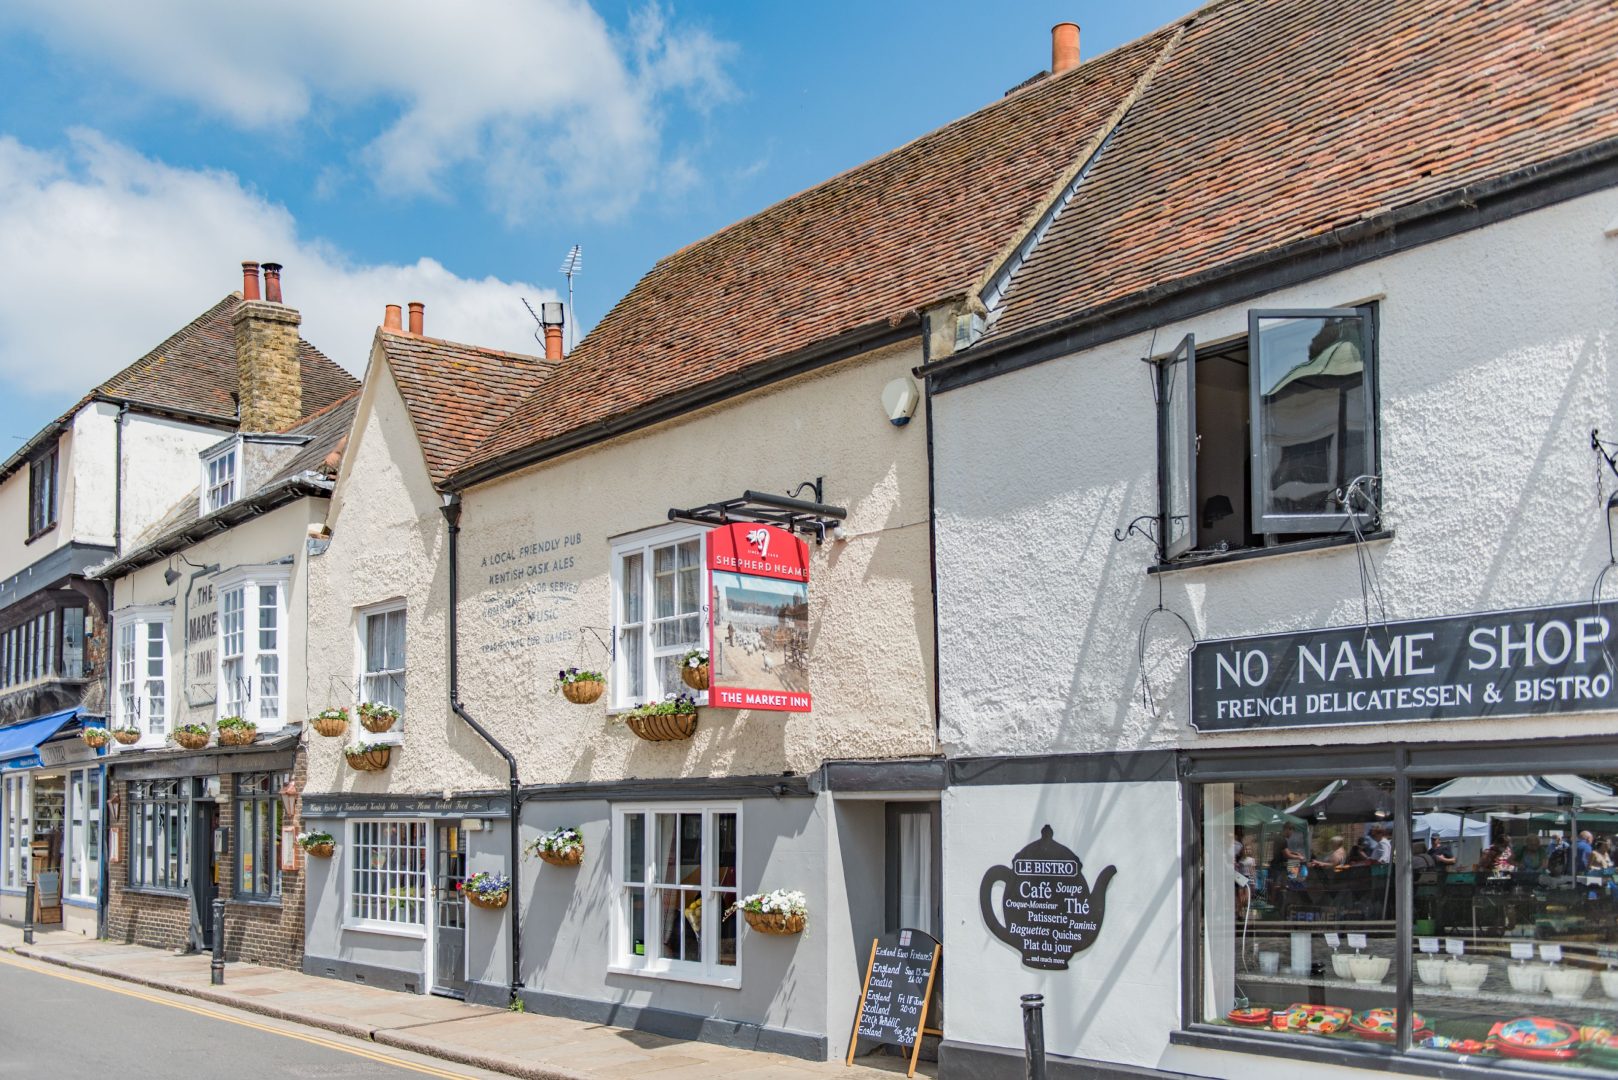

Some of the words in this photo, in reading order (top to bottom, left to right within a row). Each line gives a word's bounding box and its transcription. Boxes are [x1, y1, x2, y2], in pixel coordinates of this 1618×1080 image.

[480, 557, 487, 567] A
[490, 550, 516, 565] LOCAL
[519, 538, 560, 558] FRIENDLY
[564, 533, 582, 547] PUB
[489, 567, 524, 585] KENTISH
[526, 562, 549, 577] CASK
[552, 556, 574, 572] ALES
[716, 555, 772, 571] SHEPHERD
[774, 564, 807, 577] NEAME
[198, 584, 213, 605] THE
[549, 582, 578, 594] SERVED
[527, 606, 558, 624] MUSIC
[190, 612, 218, 642] MARKE
[545, 630, 572, 643] GAMES
[1216, 649, 1269, 690] NO
[1297, 632, 1435, 684] NAME
[1468, 616, 1610, 671] SHOP
[197, 650, 212, 677] INN
[721, 692, 742, 704] THE
[746, 694, 787, 706] MARKET
[790, 697, 808, 707] INN
[1216, 695, 1297, 719] FRENCH
[1305, 683, 1472, 714] DELICATESSEN
[1483, 682, 1503, 703] &
[1515, 674, 1610, 702] BISTRO
[456, 800, 469, 810] Food
[1018, 861, 1032, 873] LE
[1034, 862, 1073, 874] BISTRO
[1019, 881, 1052, 899] Café
[1055, 882, 1083, 896] Soupe
[1005, 898, 1058, 910] Croque-Monsieur
[1064, 898, 1090, 914] Thé
[1027, 911, 1068, 924] Patisserie
[1068, 919, 1097, 931] Paninis
[1010, 923, 1050, 936] Baguettes
[1052, 929, 1082, 941] Quiches
[1023, 939, 1040, 950] Plat
[1041, 940, 1053, 951] du
[1053, 941, 1072, 955] jour
[873, 962, 901, 974] England
[870, 976, 893, 988] Croatia
[867, 990, 891, 1002] England
[897, 993, 906, 1003] Fri
[863, 1002, 891, 1015] Scotland
[858, 1026, 882, 1037] England
